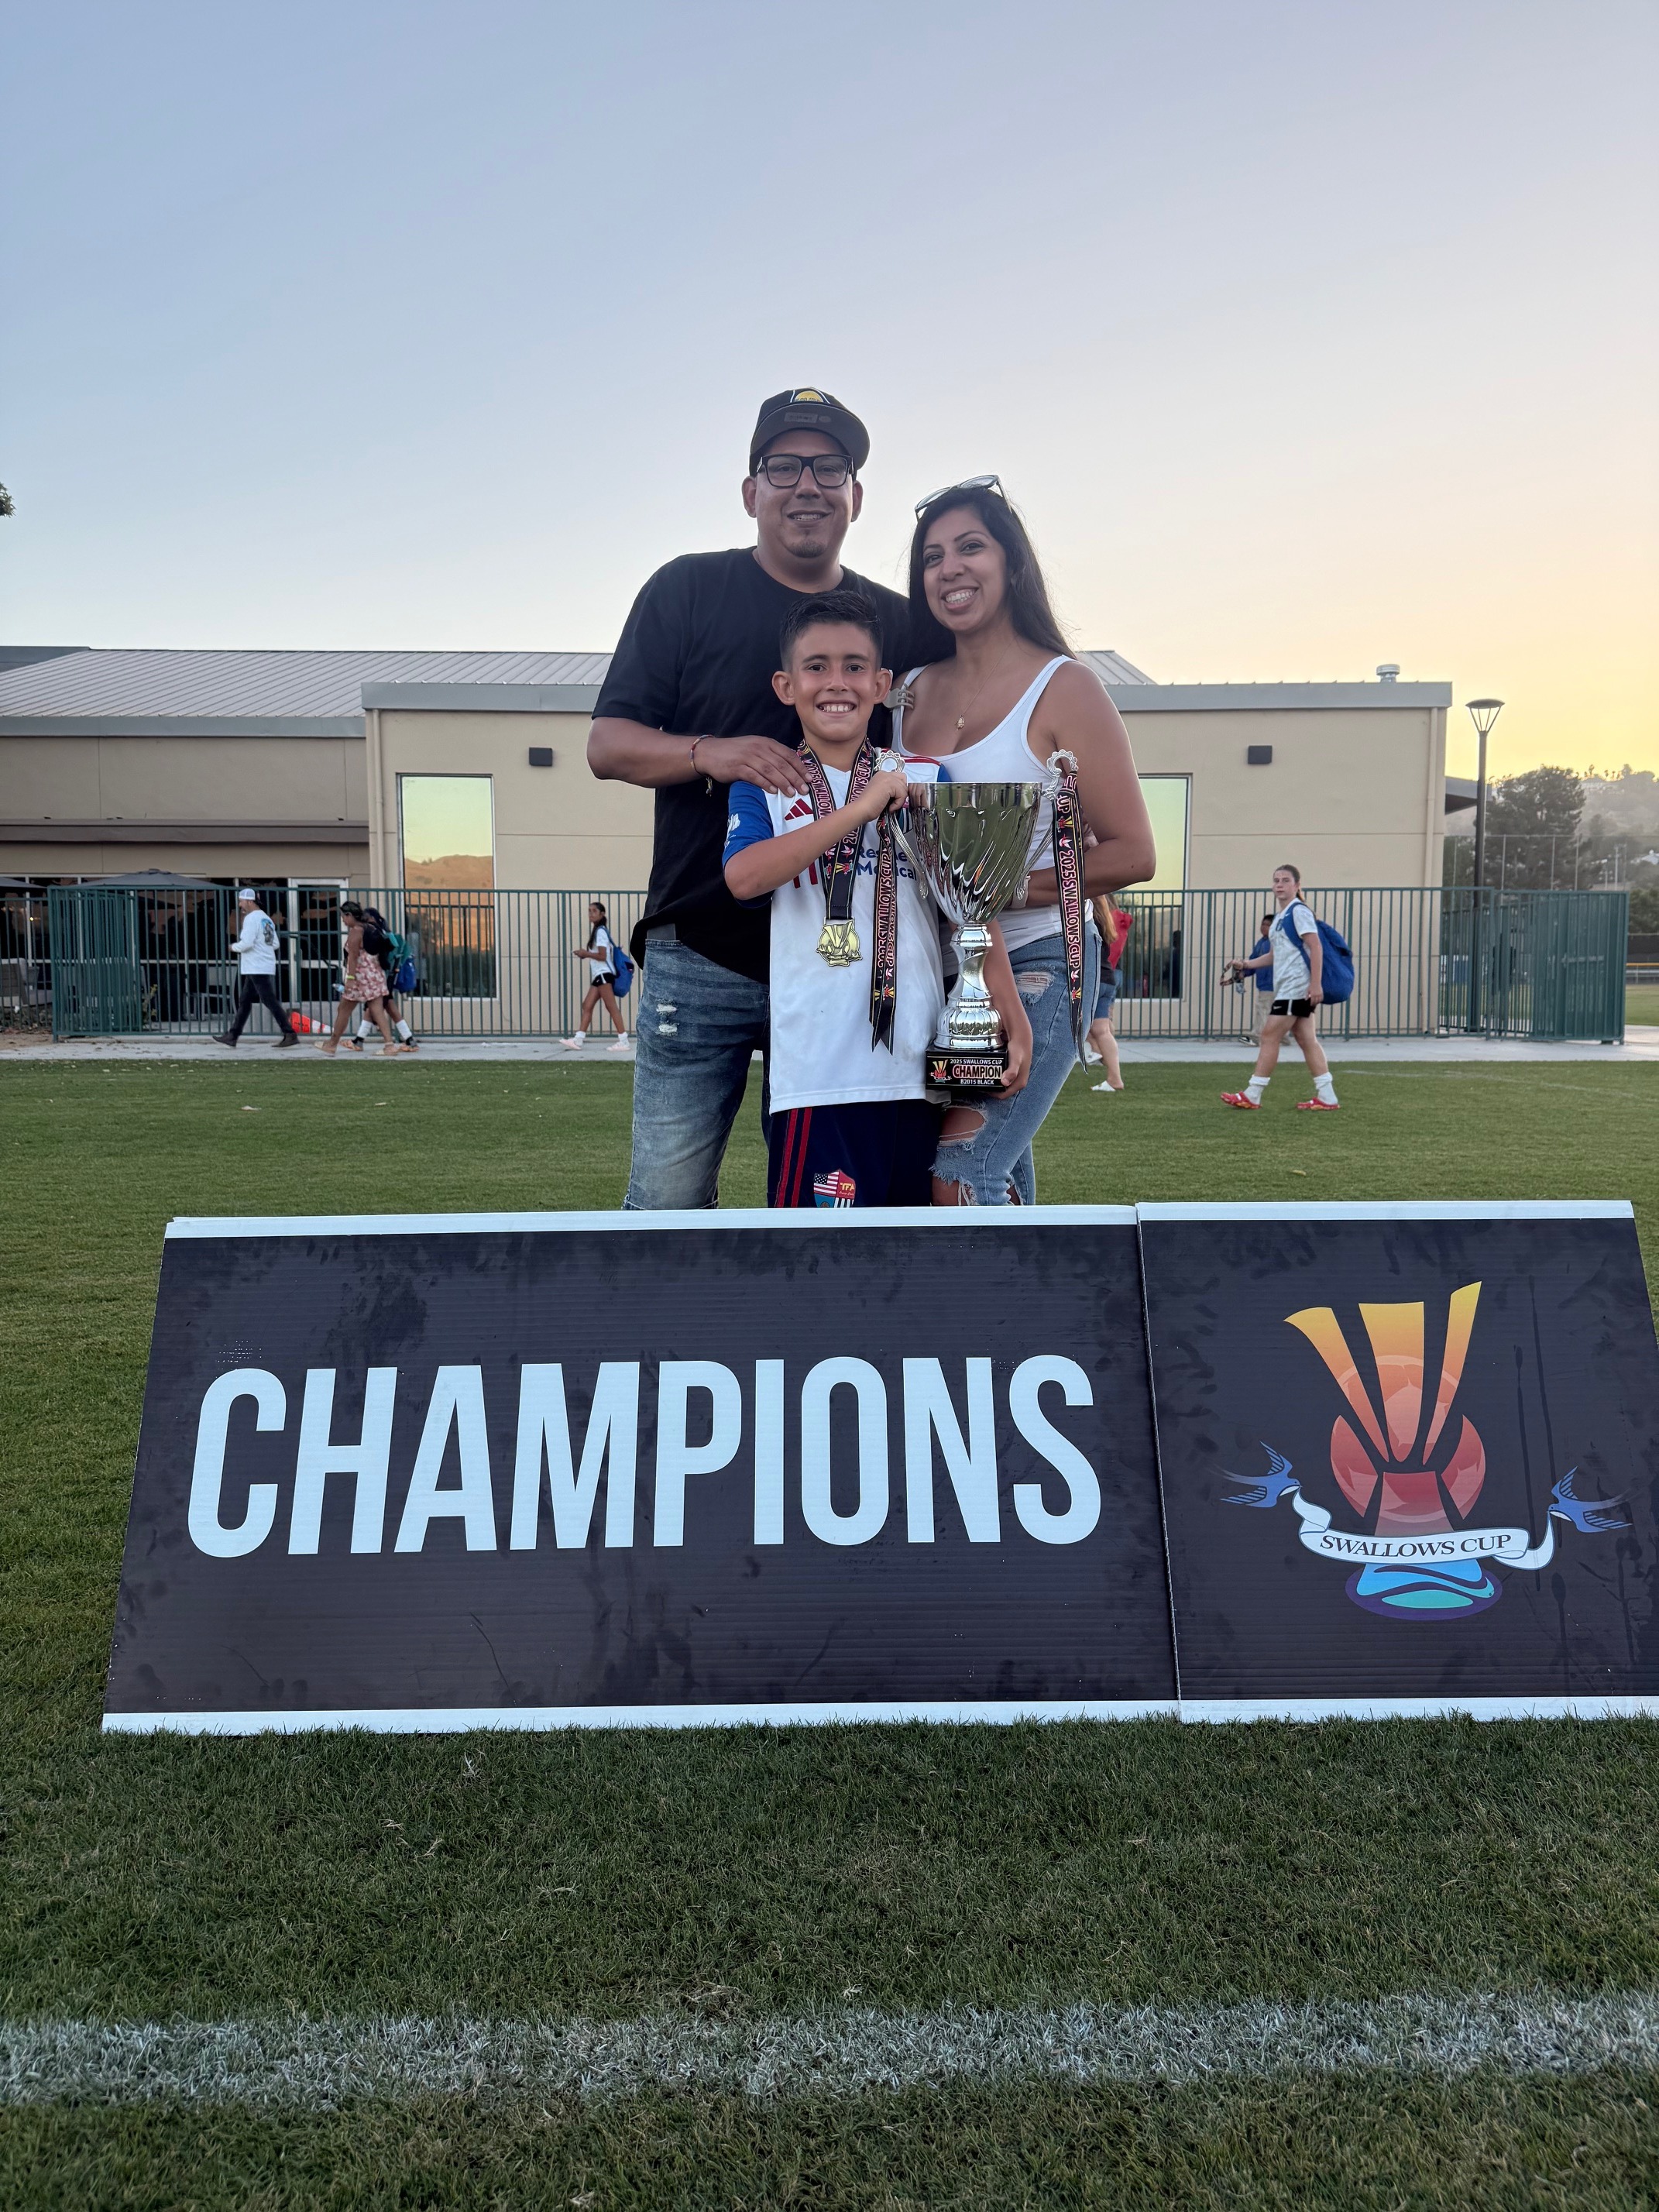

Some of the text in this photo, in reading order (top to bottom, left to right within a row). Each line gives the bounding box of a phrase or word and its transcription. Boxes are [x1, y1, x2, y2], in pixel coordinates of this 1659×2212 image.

[812, 778, 833, 819] SWALLOW
[1056, 795, 1071, 814] UP
[881, 853, 892, 878] CUP
[1059, 850, 1081, 969] 2025 SWALLOWS CUP
[952, 1064, 1003, 1080] CHAMPION
[187, 1355, 1101, 1558] CHAMPIONS
[1319, 1534, 1512, 1558] SWALLOWS CUP
